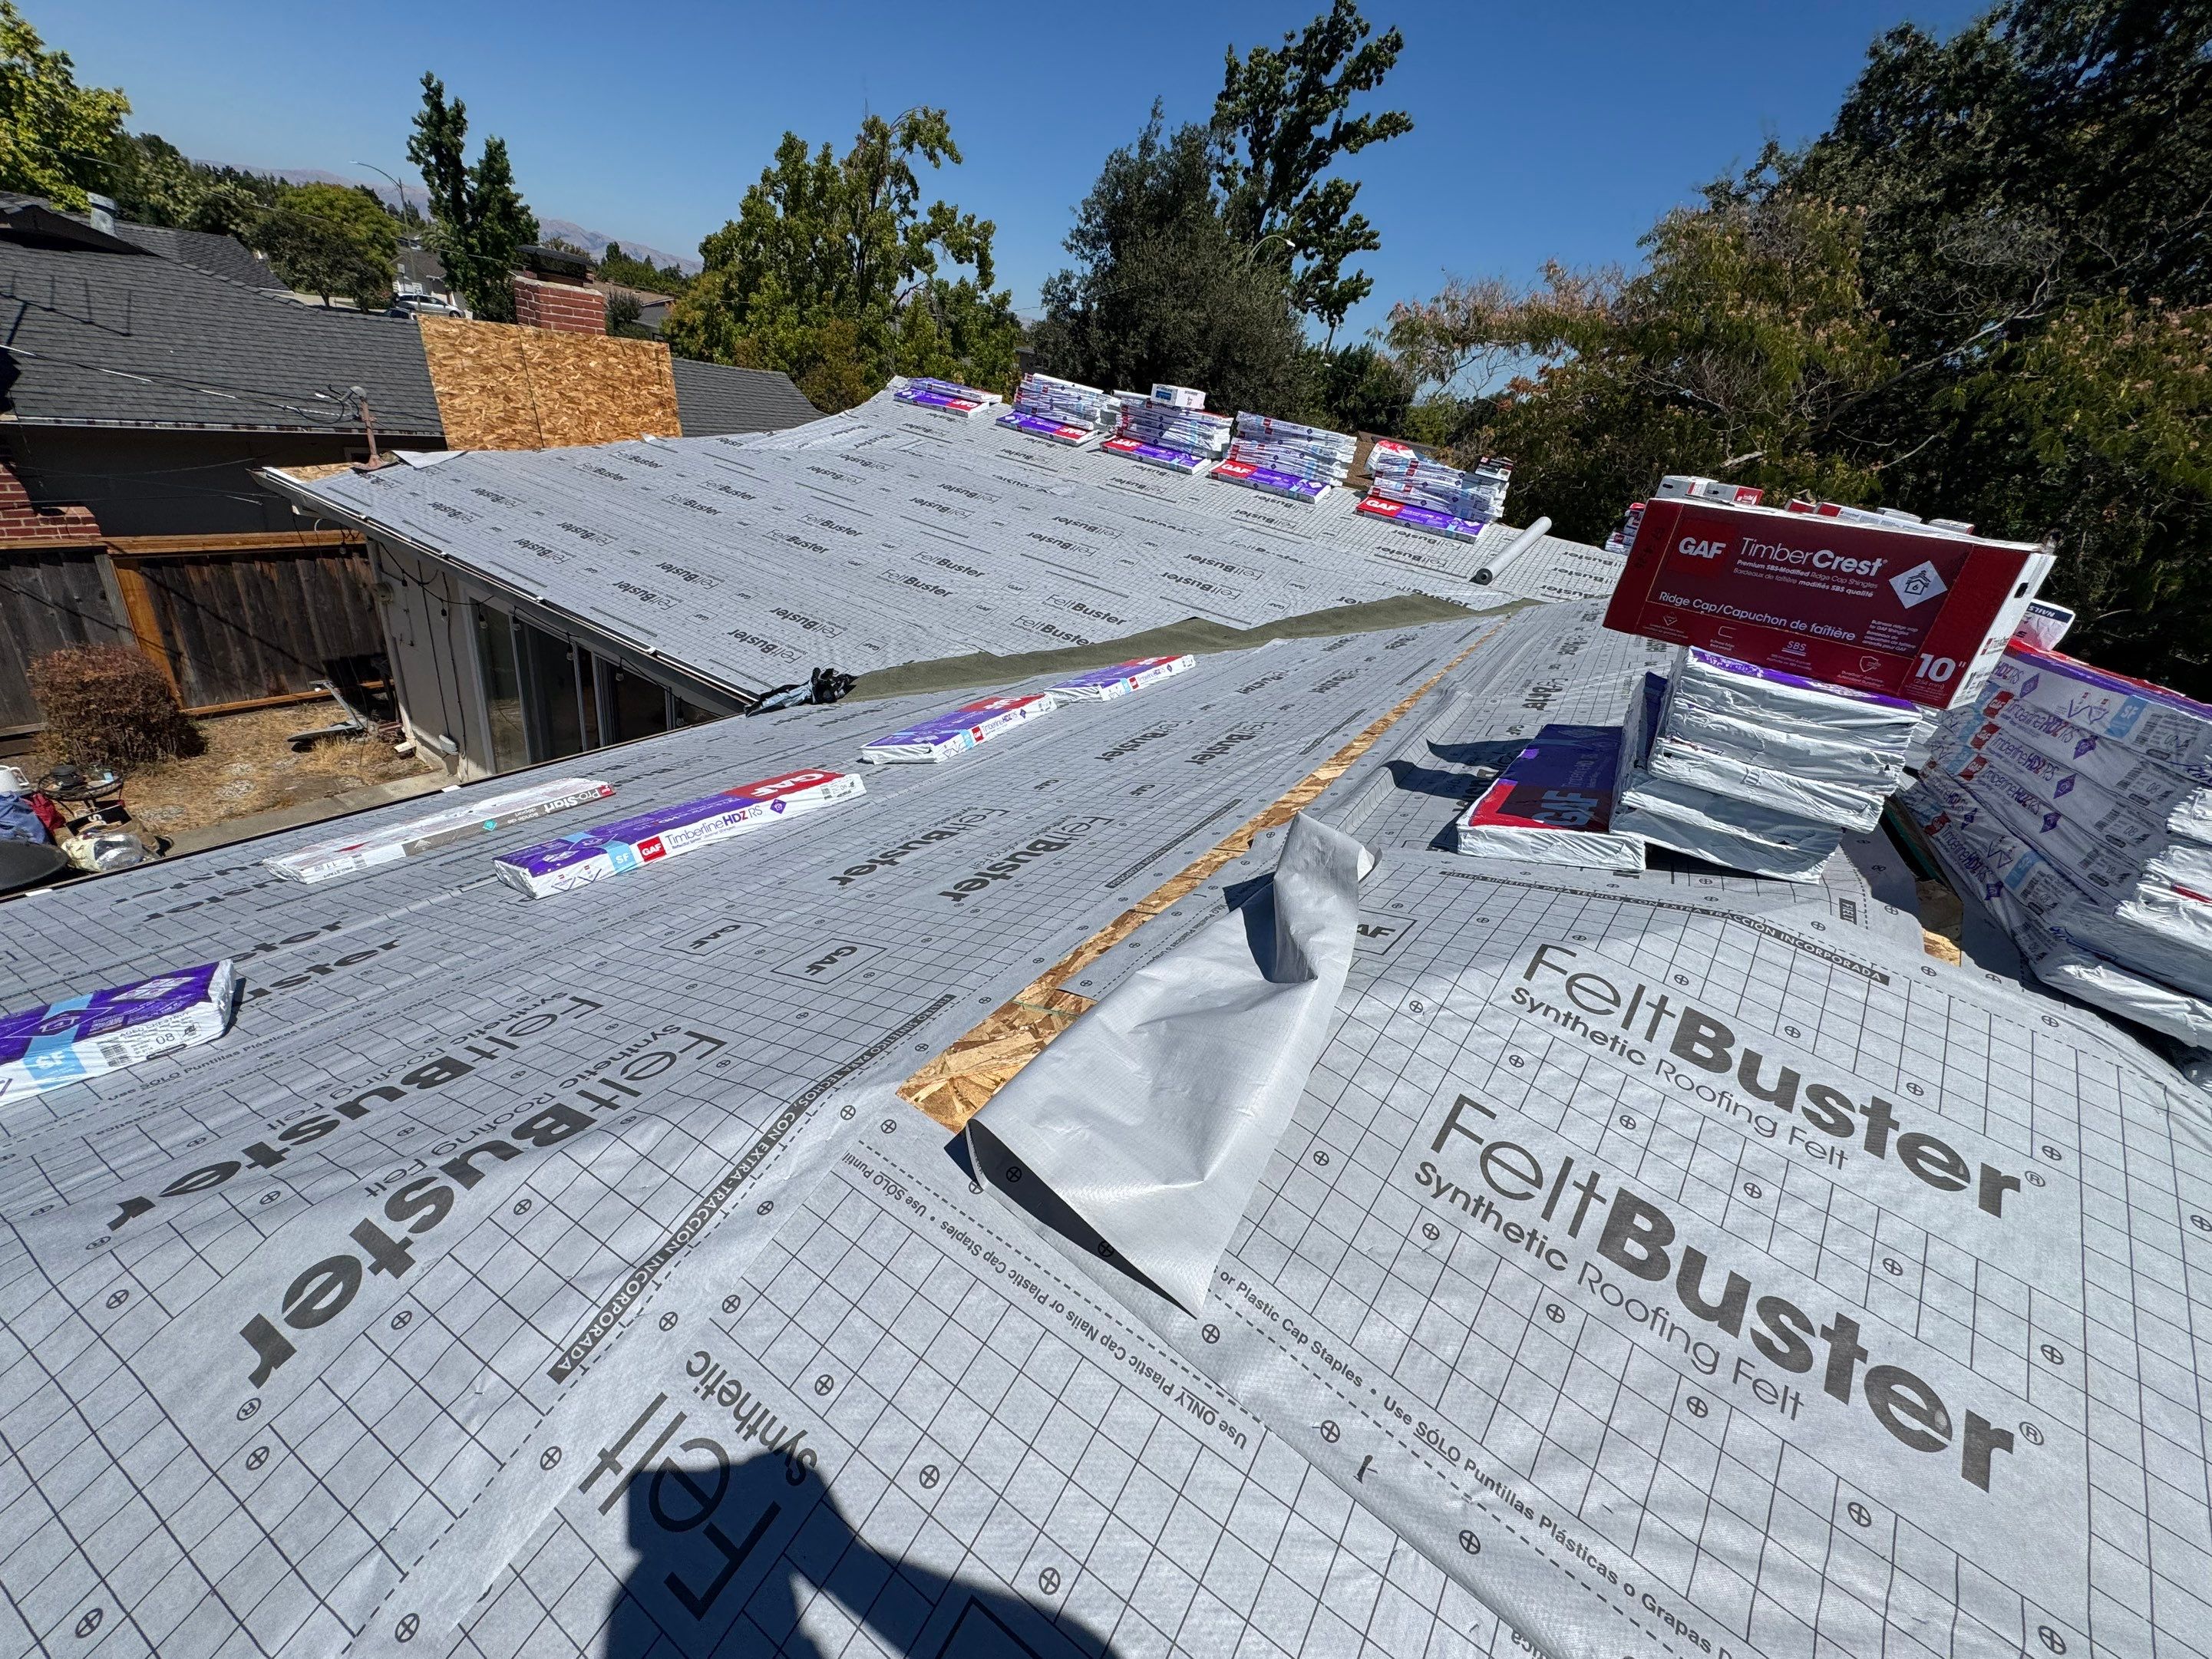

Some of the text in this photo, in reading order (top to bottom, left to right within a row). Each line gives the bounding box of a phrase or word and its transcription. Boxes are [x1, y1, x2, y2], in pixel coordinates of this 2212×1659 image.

[1365, 500, 1400, 511] GAF
[556, 521, 612, 546] FeltBuster
[802, 513, 863, 537] FeltBuster
[513, 538, 570, 565] FeltBuster
[766, 529, 830, 555] FeltBuster
[1026, 532, 1099, 556] FeltBuster
[1679, 537, 1726, 561] GAF
[655, 562, 720, 589] FeltBuster
[915, 551, 985, 579] FeltBuster
[1184, 552, 1263, 581] FeltBuster
[1737, 559, 1766, 571] Premium
[1766, 564, 1810, 577] SBS-Modified
[1847, 576, 1878, 589] Shingles
[612, 579, 678, 611] FeltBuster
[882, 568, 953, 598] FeltBuster
[1161, 572, 1241, 600] FeltBuster
[1831, 584, 1845, 592] SBS
[1846, 586, 1874, 599] qualité
[768, 606, 844, 639] FeltBuster
[1047, 594, 1127, 625] FeltBuster
[1659, 591, 1856, 641] Ridge Cap/Capuchon de faîtière
[2028, 605, 2055, 618] NAILS
[727, 628, 804, 665] FeltBuster
[1787, 641, 1807, 651] SBS
[2120, 705, 2139, 721] SF
[1185, 721, 1277, 765] FeltBuster
[750, 772, 825, 797] GAF
[543, 788, 601, 813] Pro-Start
[1532, 790, 1599, 826] GAF
[642, 805, 763, 858] GAF TimberlineHDZ RS
[615, 853, 630, 866] SF
[828, 808, 1009, 887] FeltBuster
[937, 816, 1114, 902] FeltBuster
[688, 924, 741, 951] GAF
[1356, 925, 1395, 938] AF
[804, 945, 857, 977] GAF
[1781, 930, 1882, 982] INCORPORADA
[451, 991, 569, 1044] Synthetic
[155, 1034, 175, 1045] 08
[328, 1046, 449, 1100] Roofing
[1511, 986, 1848, 1170] Synthetic Roofing Felt
[266, 1101, 324, 1133] Felt
[363, 1024, 682, 1199] Synthetic Roofing Felt
[768, 1111, 794, 1142] CON
[903, 1196, 928, 1218] Use
[939, 1219, 982, 1258] Staples
[982, 1249, 1007, 1275] Cap
[1006, 1265, 1050, 1307] Plastic
[1415, 1161, 1805, 1421] Synthetic Roofing Felt
[558, 1248, 665, 1374] INCORPORADA
[1048, 1300, 1065, 1314] or
[1065, 1308, 1098, 1342] Nails
[1099, 1332, 1127, 1361] Cap
[1128, 1354, 1173, 1403] Plastic
[685, 1350, 818, 1486] Synthetic
[1174, 1386, 1219, 1427] ONLY
[1218, 1419, 1249, 1450] Use
[1220, 1271, 1712, 1655] or Plastic Cap Staples Use SÓLO Puntillas Plásticas o Grapas
